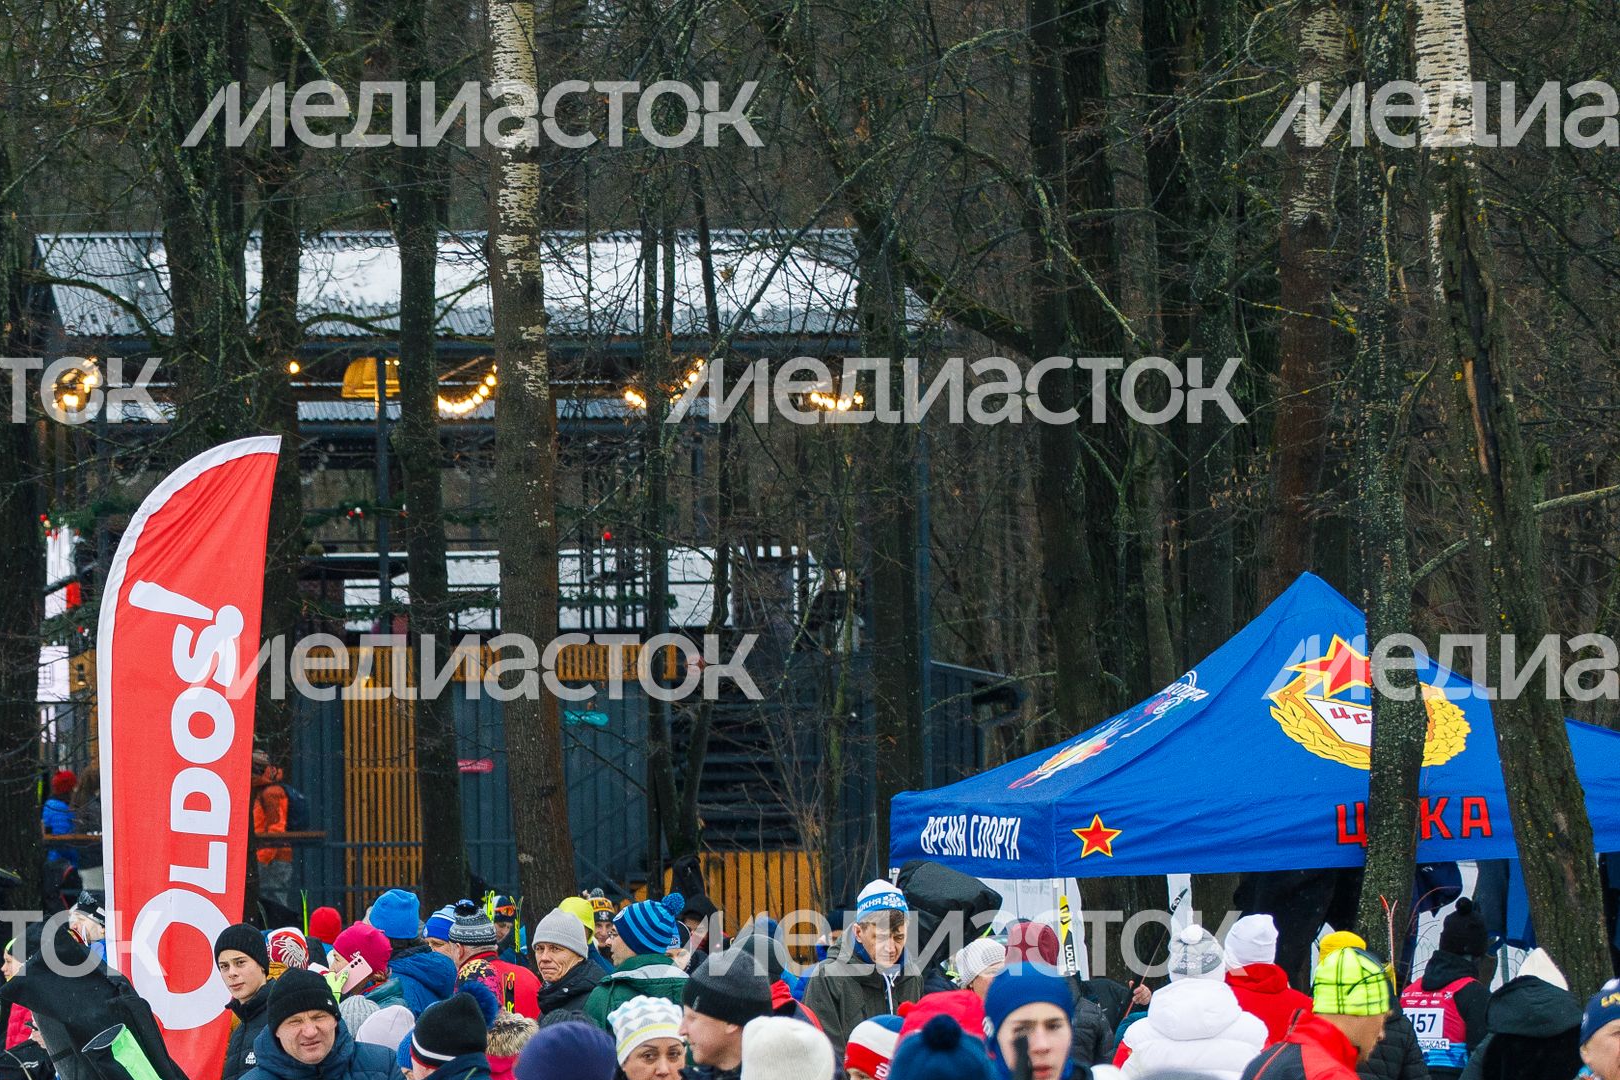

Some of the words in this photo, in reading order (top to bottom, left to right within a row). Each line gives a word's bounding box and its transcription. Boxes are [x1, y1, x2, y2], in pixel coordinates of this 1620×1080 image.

[128, 580, 244, 1031] OLDOS!
[1335, 795, 1493, 848] ЦКА
[920, 815, 967, 857] ВРЕМЯ
[970, 814, 1021, 860] СПОРТА
